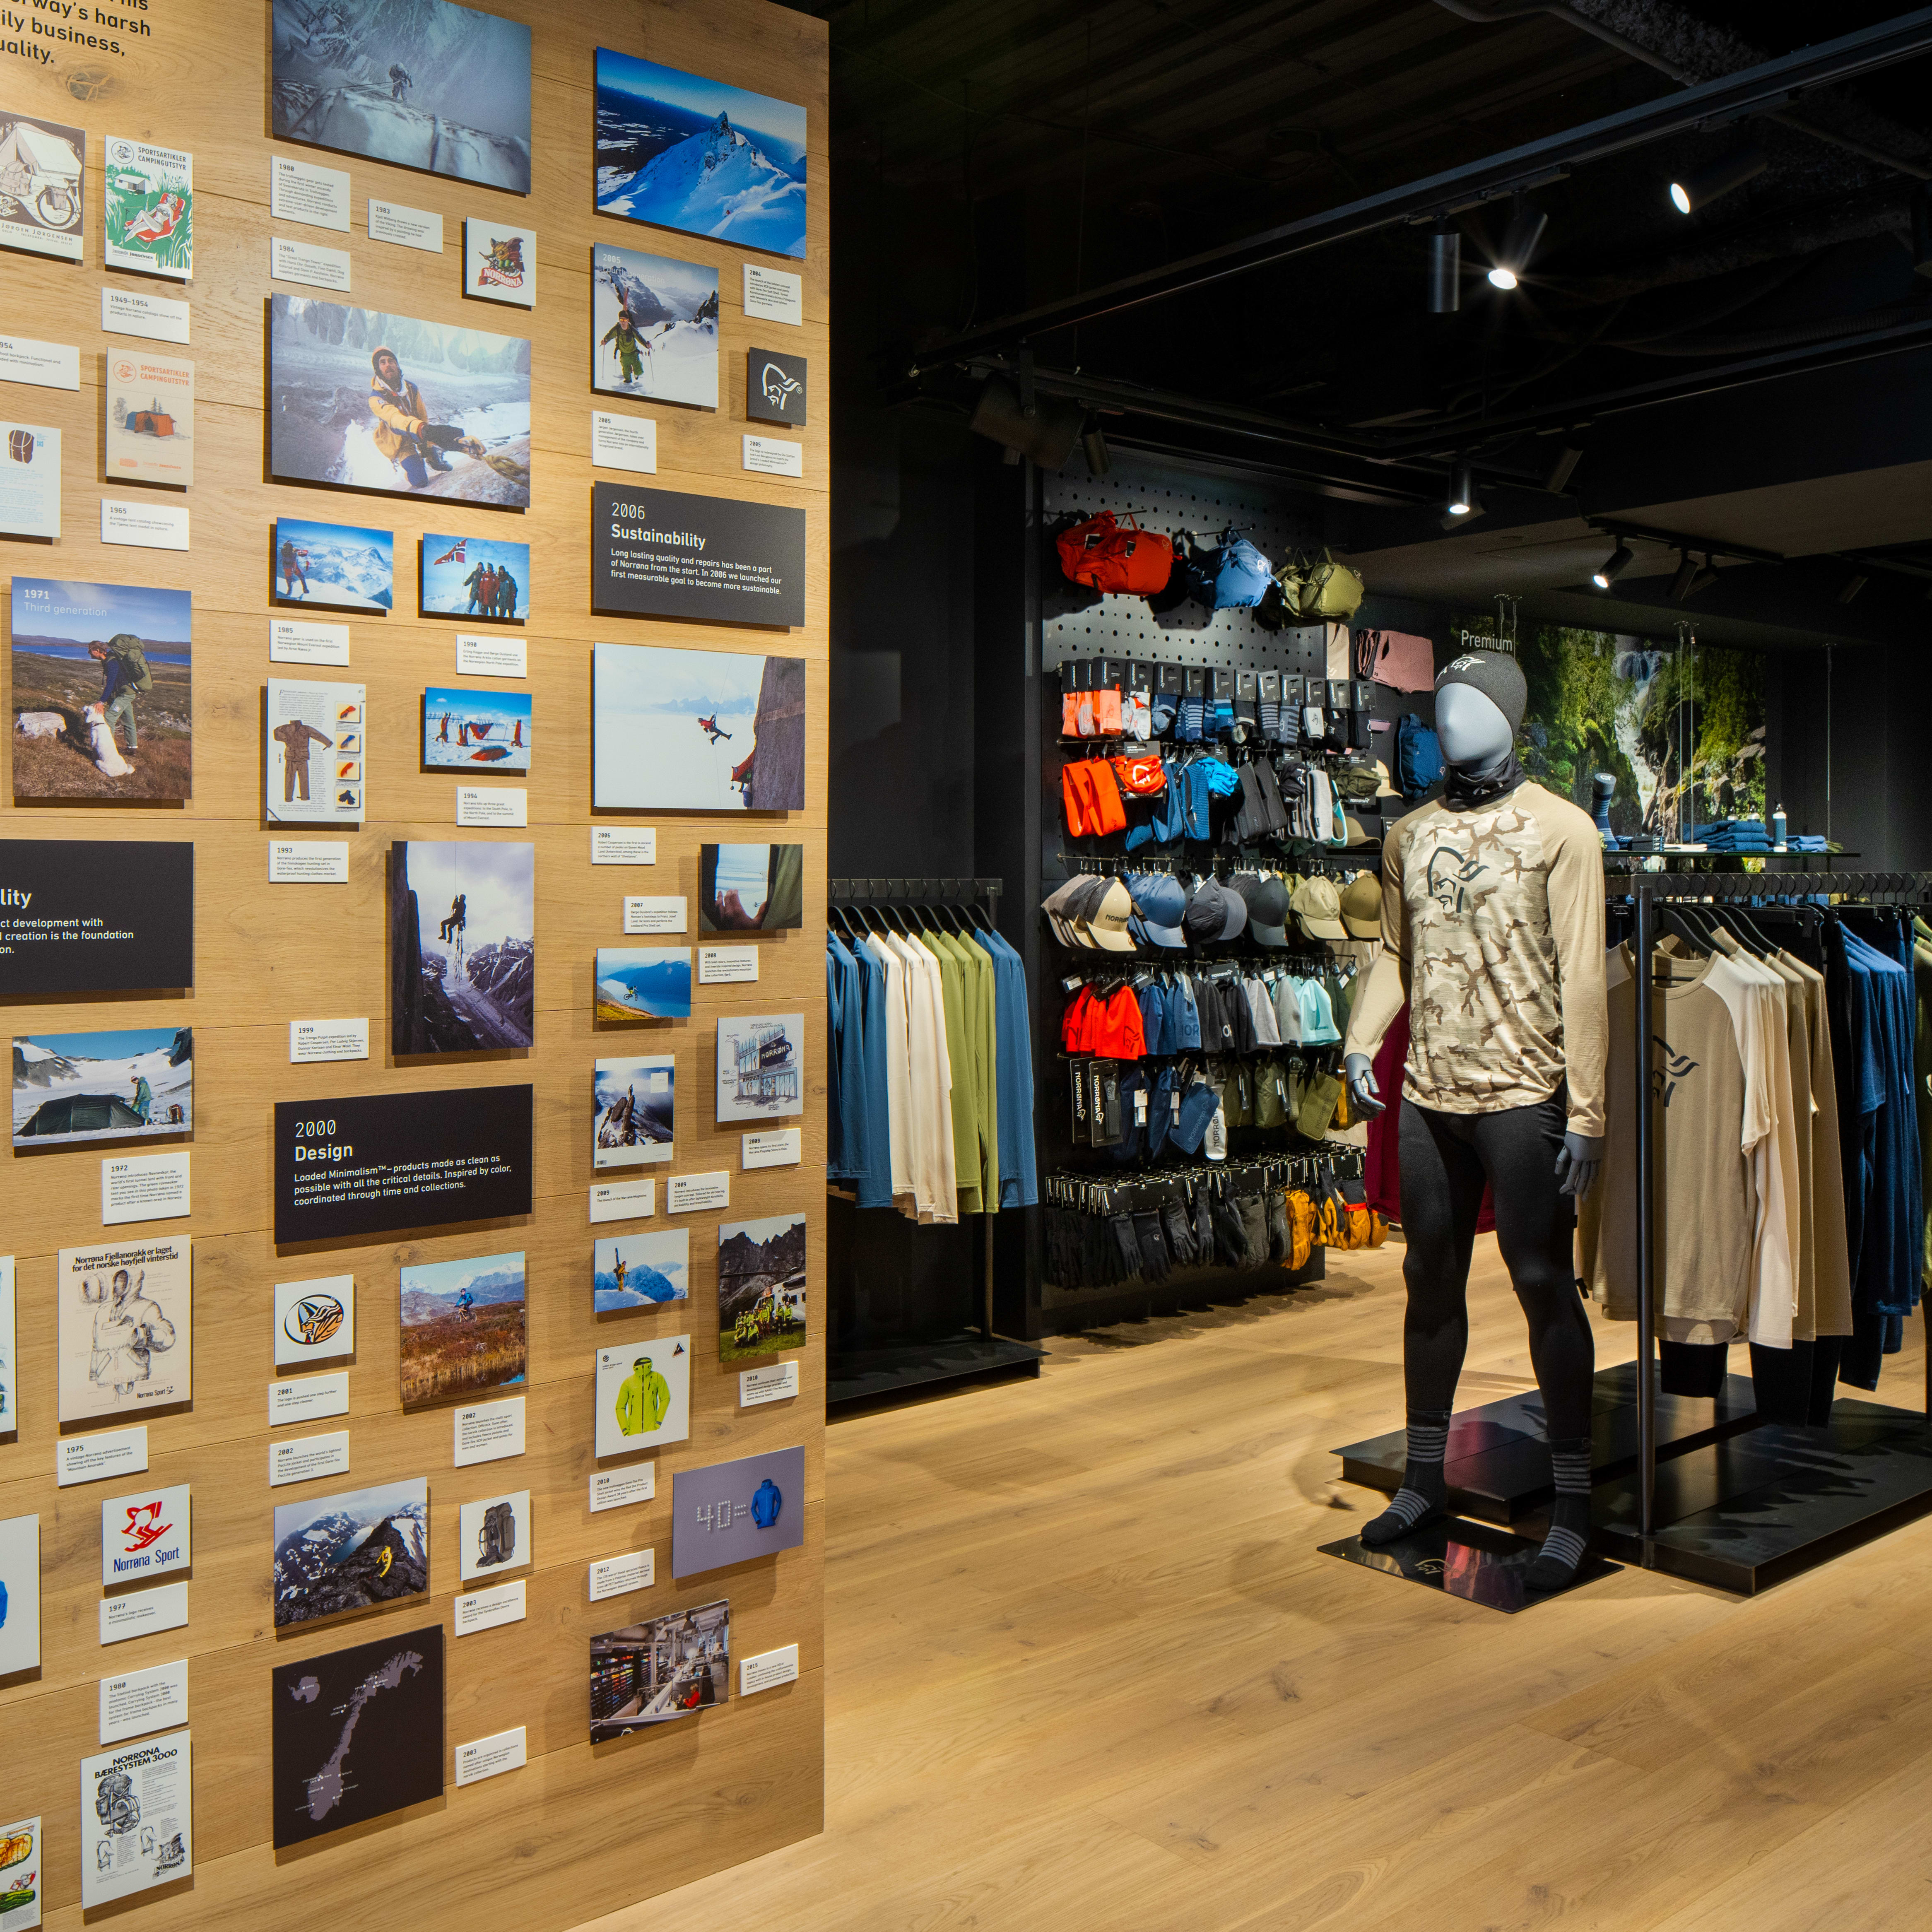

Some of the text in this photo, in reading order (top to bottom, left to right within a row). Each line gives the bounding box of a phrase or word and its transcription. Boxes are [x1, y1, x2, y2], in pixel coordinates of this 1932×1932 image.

[11, 0, 150, 36] way's harsh
[32, 17, 125, 57] business,
[138, 147, 186, 162] SPORTSARTIKLER
[138, 155, 185, 170] CAMPINGUTSTYR
[2, 223, 72, 241] JØRGEN JØRGENSEN
[603, 254, 620, 264] 2005
[484, 268, 523, 287] NORRØNA
[603, 265, 665, 283] Fourth generation
[111, 296, 148, 307] 1949–1954
[140, 373, 189, 386] CAMPINGUTSTYR
[141, 365, 189, 378] SPORTSARTIKLER
[612, 503, 645, 519] 2006
[612, 524, 706, 550] Sustainability
[612, 548, 628, 559] Long
[631, 551, 654, 561] lasting
[656, 555, 679, 564] quality
[620, 560, 648, 570] Norrøna
[740, 573, 769, 583] launched
[628, 573, 669, 583] measurable
[696, 579, 722, 588] become
[742, 585, 781, 594] sustainable.
[25, 590, 49, 599] 1971
[24, 602, 106, 616] Third generation
[1462, 630, 1512, 651] Premium
[0, 888, 32, 909] lity
[13, 919, 79, 929] development
[1105, 914, 1129, 923] NORR
[5, 932, 47, 940] creation
[63, 931, 78, 940] the
[81, 930, 133, 939] foundation
[761, 1044, 790, 1060] NORRØNA
[296, 1120, 335, 1137] 2000
[1188, 1111, 1207, 1142] NORRØNA
[296, 1144, 352, 1161] Design
[295, 1171, 326, 1182] Loaded
[432, 1159, 453, 1168] made
[468, 1157, 488, 1168] clean
[491, 1156, 501, 1166] as
[295, 1183, 330, 1195] possible
[333, 1181, 351, 1189] with
[383, 1174, 410, 1184] critical
[413, 1172, 442, 1181] details.
[445, 1168, 477, 1178] Inspired
[294, 1193, 345, 1205] coordinated
[348, 1190, 380, 1200] through
[404, 1185, 419, 1194] and
[421, 1182, 465, 1192] collections.
[96, 1259, 119, 1269] norske
[120, 1256, 145, 1266] høyfjell
[147, 1252, 178, 1262] vinterstid
[105, 1249, 146, 1262] Fjellanorakk
[154, 1389, 166, 1397] Sport
[114, 1547, 179, 1572] Norrøna Sport
[110, 1603, 125, 1612] 1977
[110, 1682, 125, 1691] 1980
[95, 1749, 177, 1778] BÆRESYSTEM 3000
